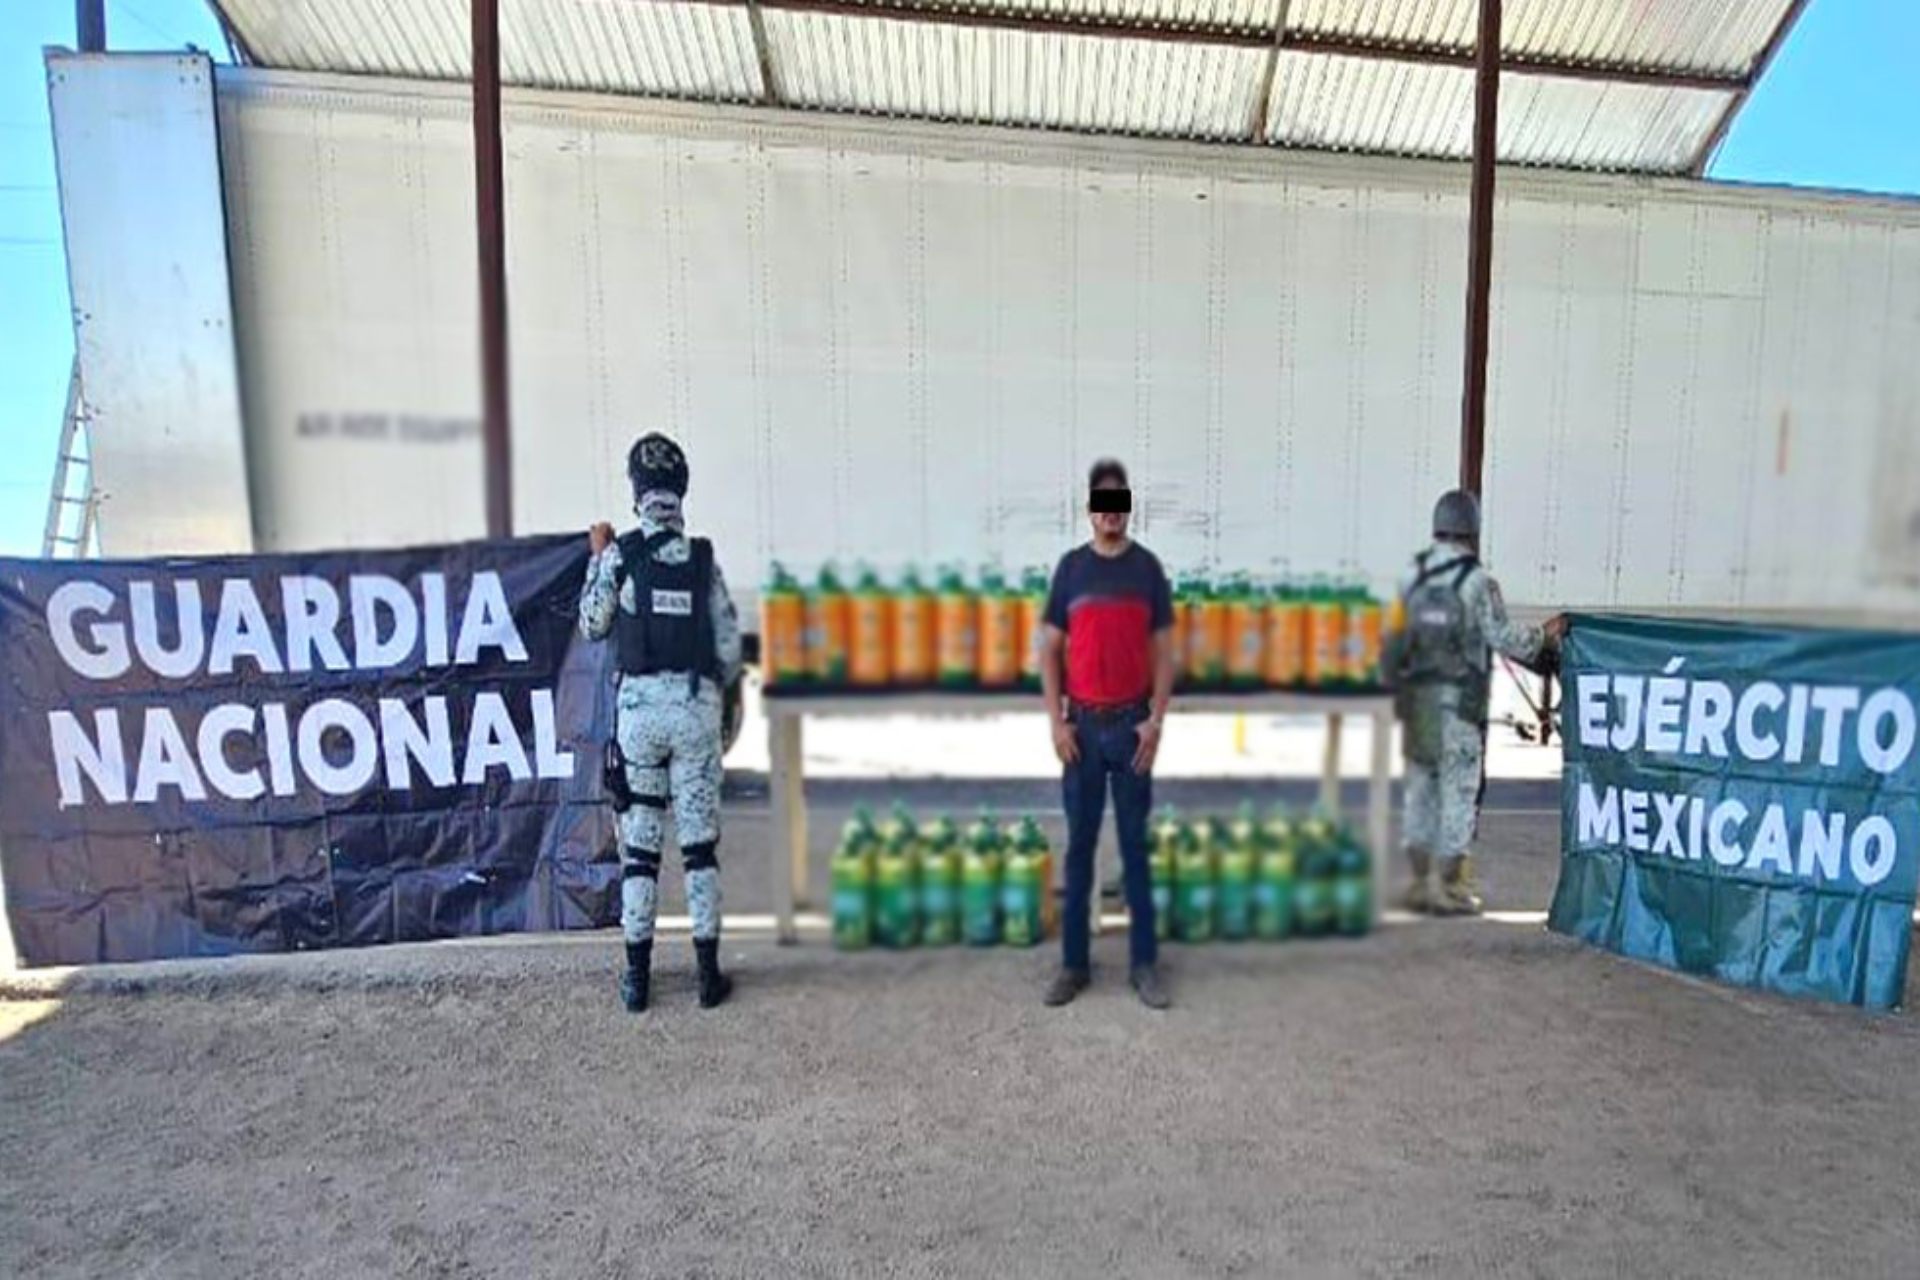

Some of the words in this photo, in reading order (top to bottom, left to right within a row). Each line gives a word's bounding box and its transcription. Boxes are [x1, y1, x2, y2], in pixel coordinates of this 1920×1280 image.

[46, 571, 528, 679] GUARDIA
[48, 689, 574, 810] NACIONAL
[1576, 657, 1916, 773] EJÉRCITO
[1577, 783, 1897, 885] MEXICANO
